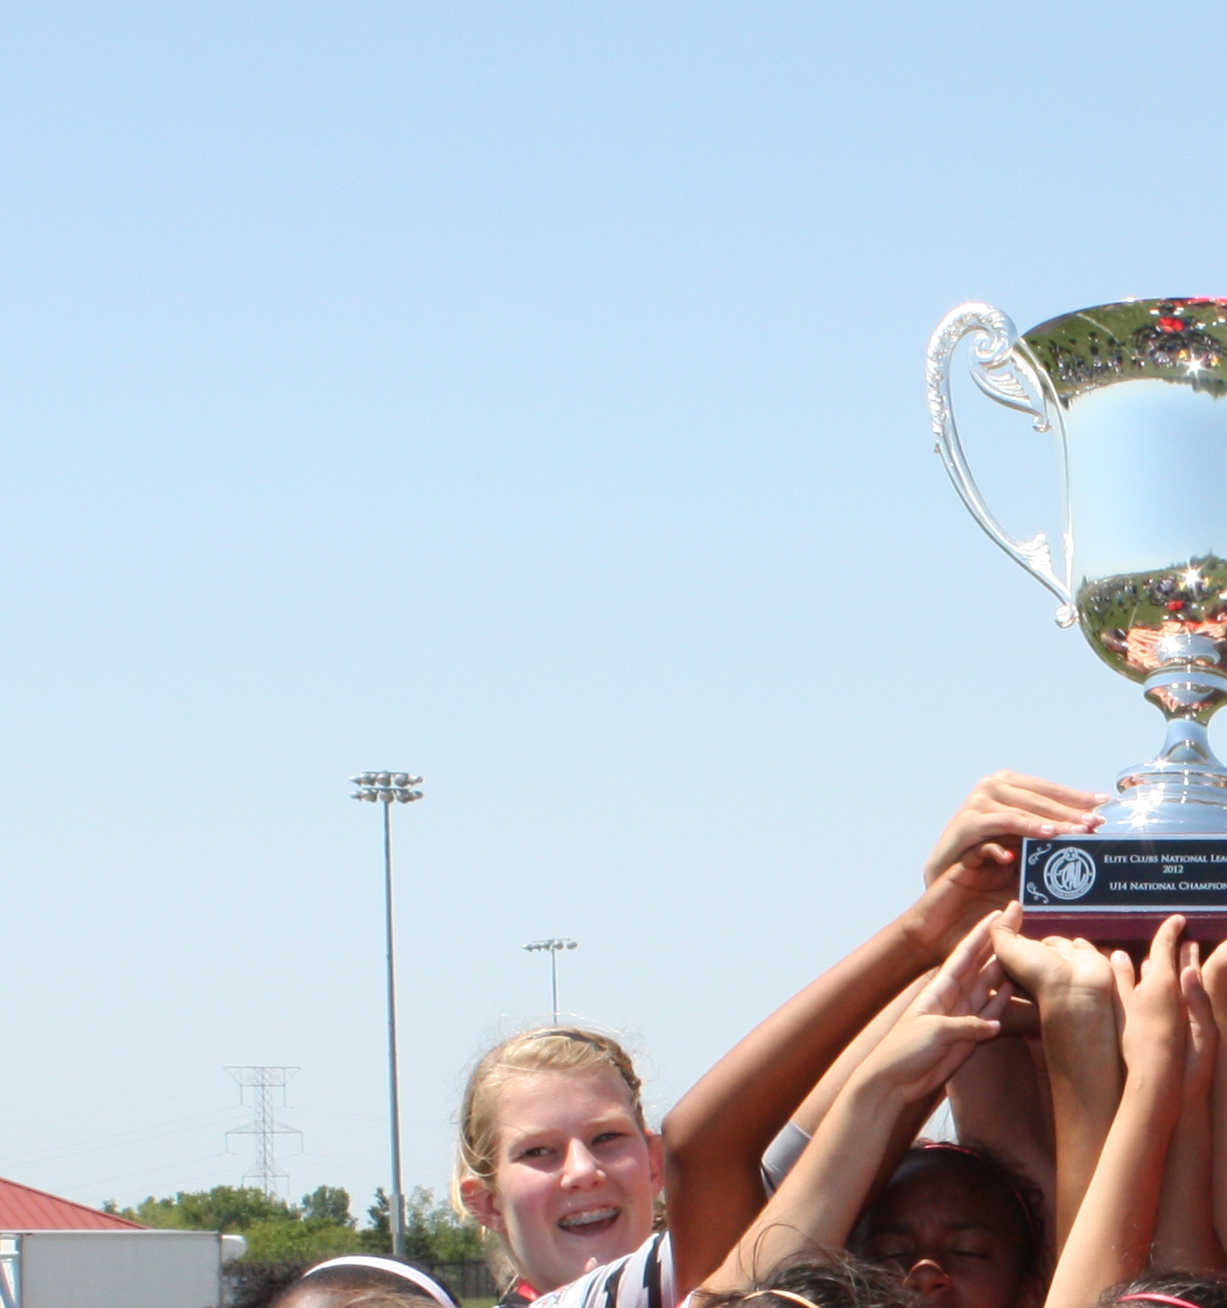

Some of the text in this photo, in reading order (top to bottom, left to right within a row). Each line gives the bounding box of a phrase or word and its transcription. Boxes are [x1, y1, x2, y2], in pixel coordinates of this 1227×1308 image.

[1160, 854, 1208, 863] NATIONAL
[1162, 864, 1184, 874] 2012
[1109, 882, 1128, 891] U14
[1130, 882, 1177, 891] NATIONAL
